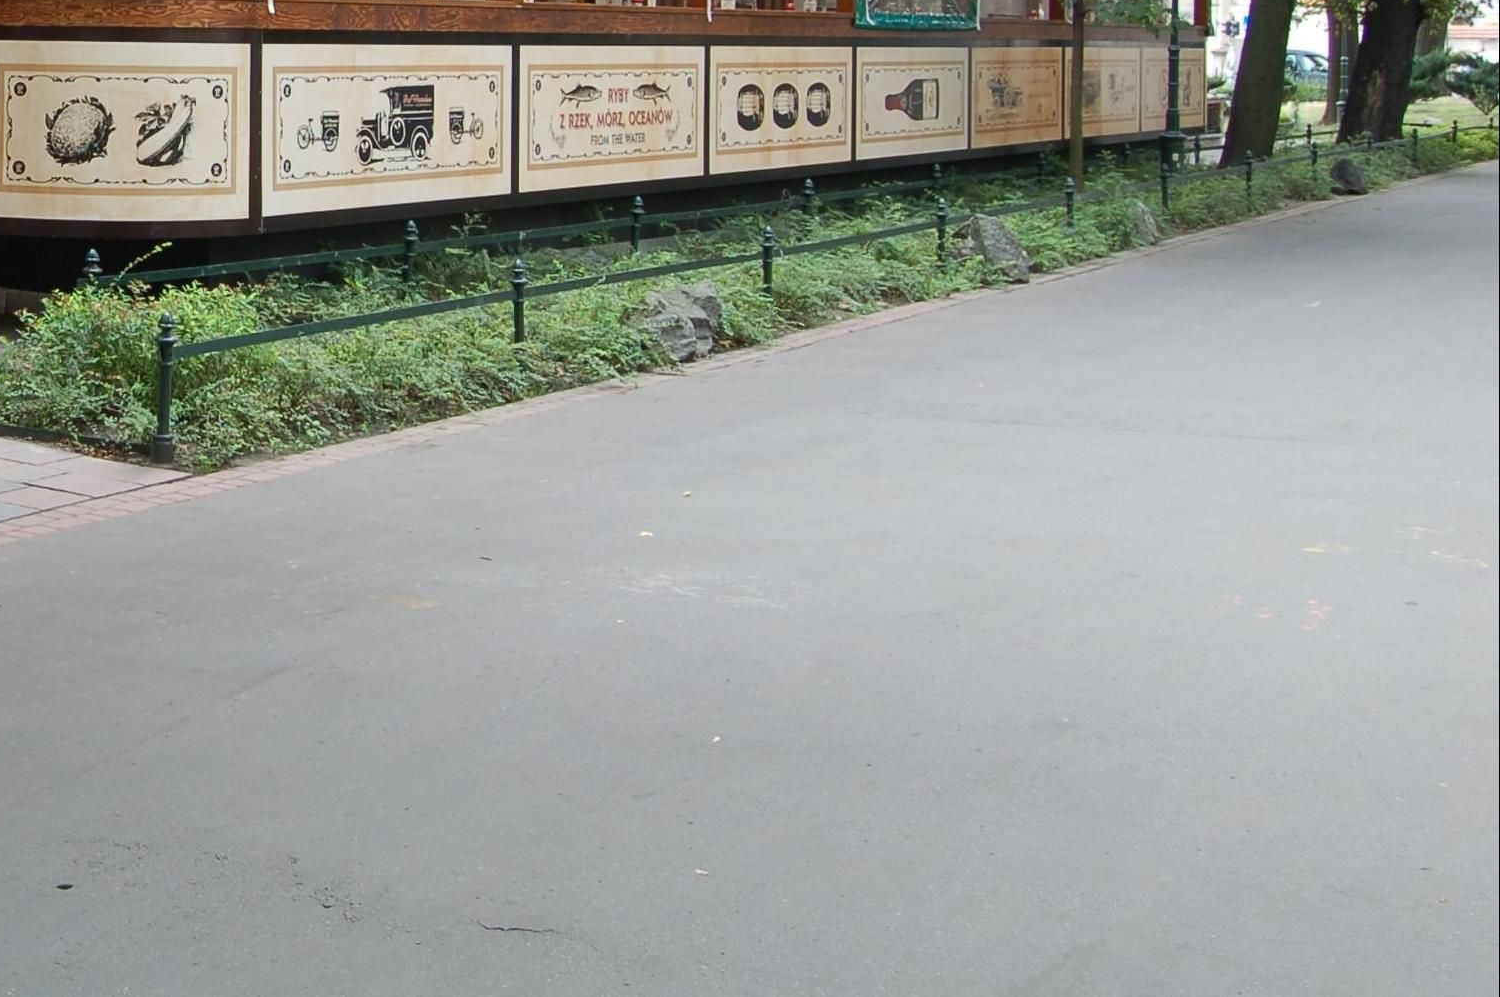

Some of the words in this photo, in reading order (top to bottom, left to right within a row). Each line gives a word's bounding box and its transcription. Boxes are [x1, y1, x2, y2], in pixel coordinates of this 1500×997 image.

[608, 88, 629, 103] RYBY
[559, 113, 565, 129] Z
[568, 113, 594, 130] RZEK,
[628, 106, 673, 125] OCEANÓW
[591, 134, 610, 146] FROM
[611, 133, 623, 145] THE
[625, 132, 645, 144] WATER
